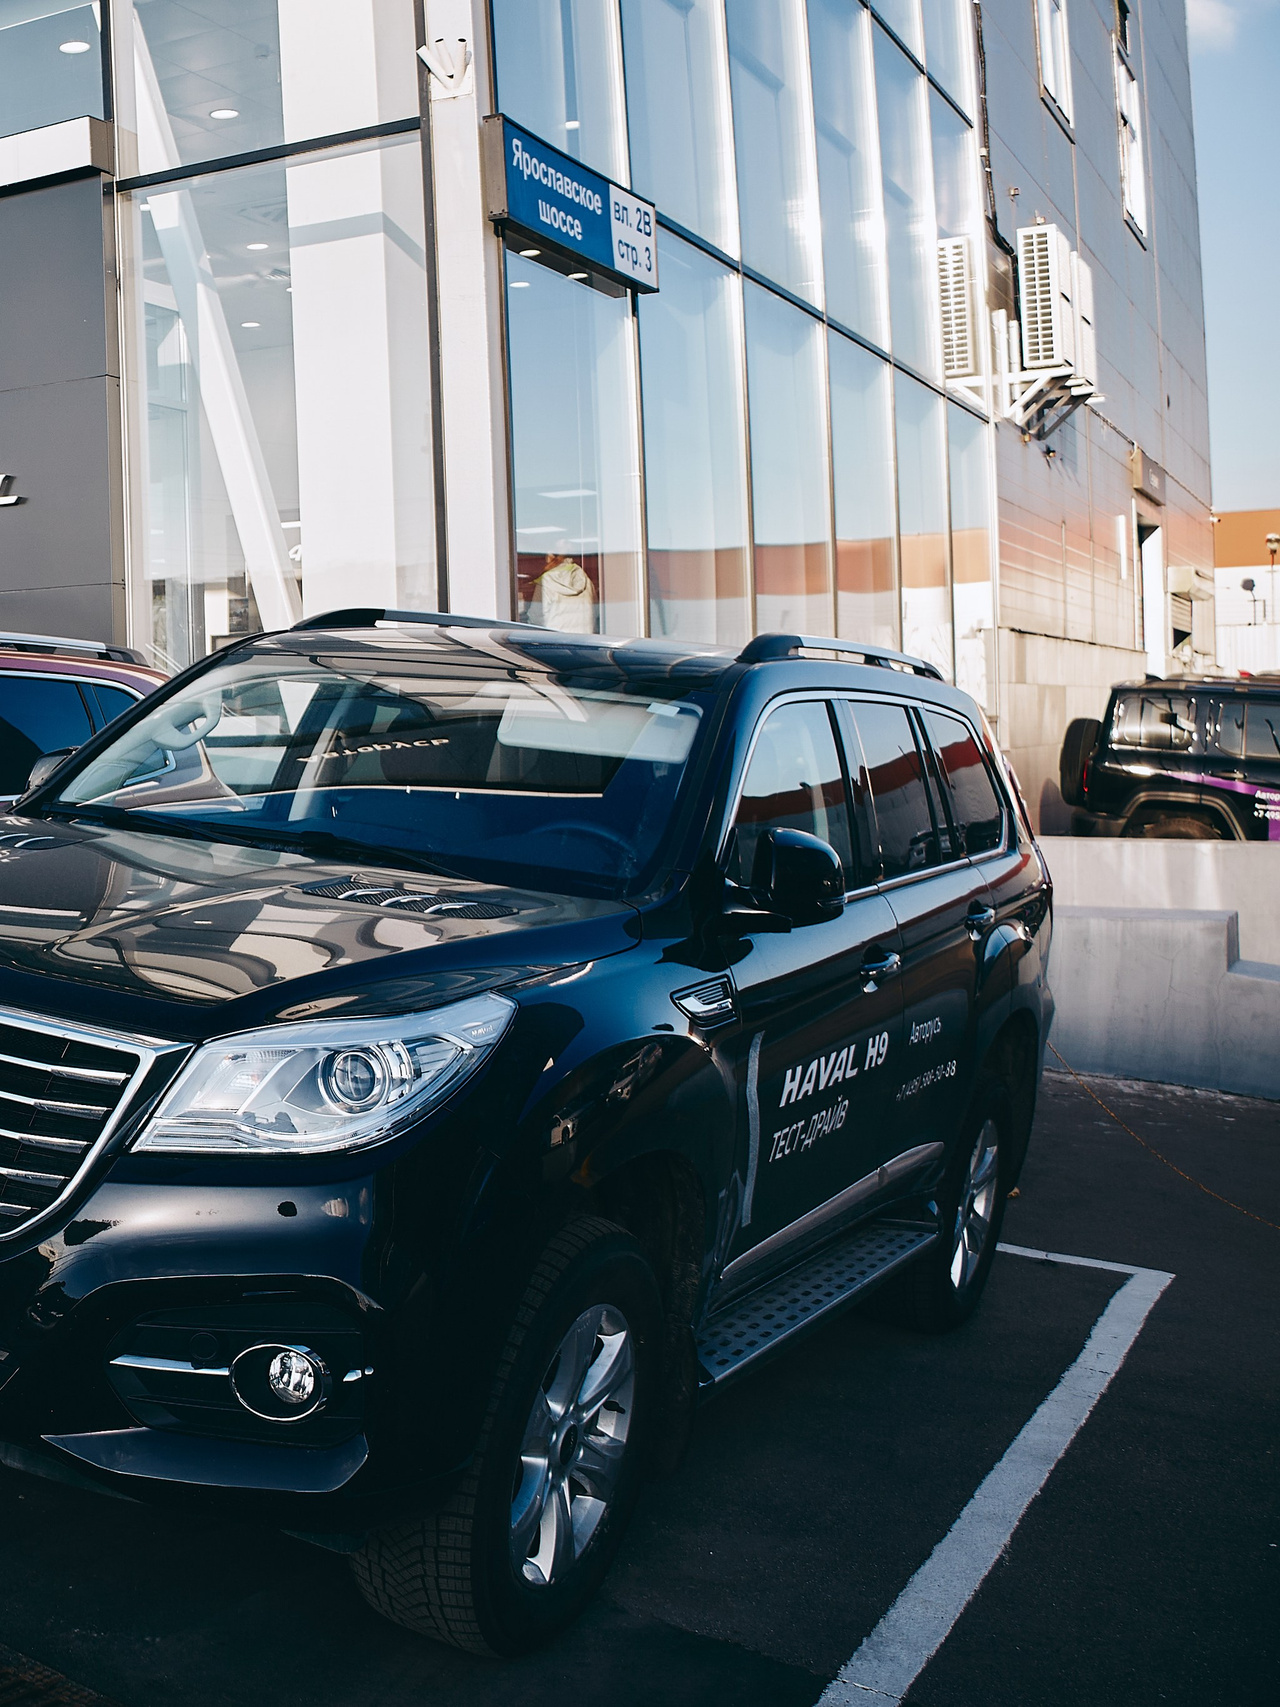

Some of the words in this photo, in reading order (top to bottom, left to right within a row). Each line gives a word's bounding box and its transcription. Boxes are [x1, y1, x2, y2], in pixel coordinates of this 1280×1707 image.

[512, 138, 602, 215] Ярославское
[538, 199, 583, 241] шоссе
[613, 201, 632, 228] вл.
[636, 207, 652, 237] 2В
[617, 239, 642, 271] стр.
[645, 247, 652, 272] 3
[779, 1043, 859, 1108] HAVAL
[864, 1031, 889, 1071] H9
[769, 1095, 849, 1163] ТЕСТ-ДРАЙВ
